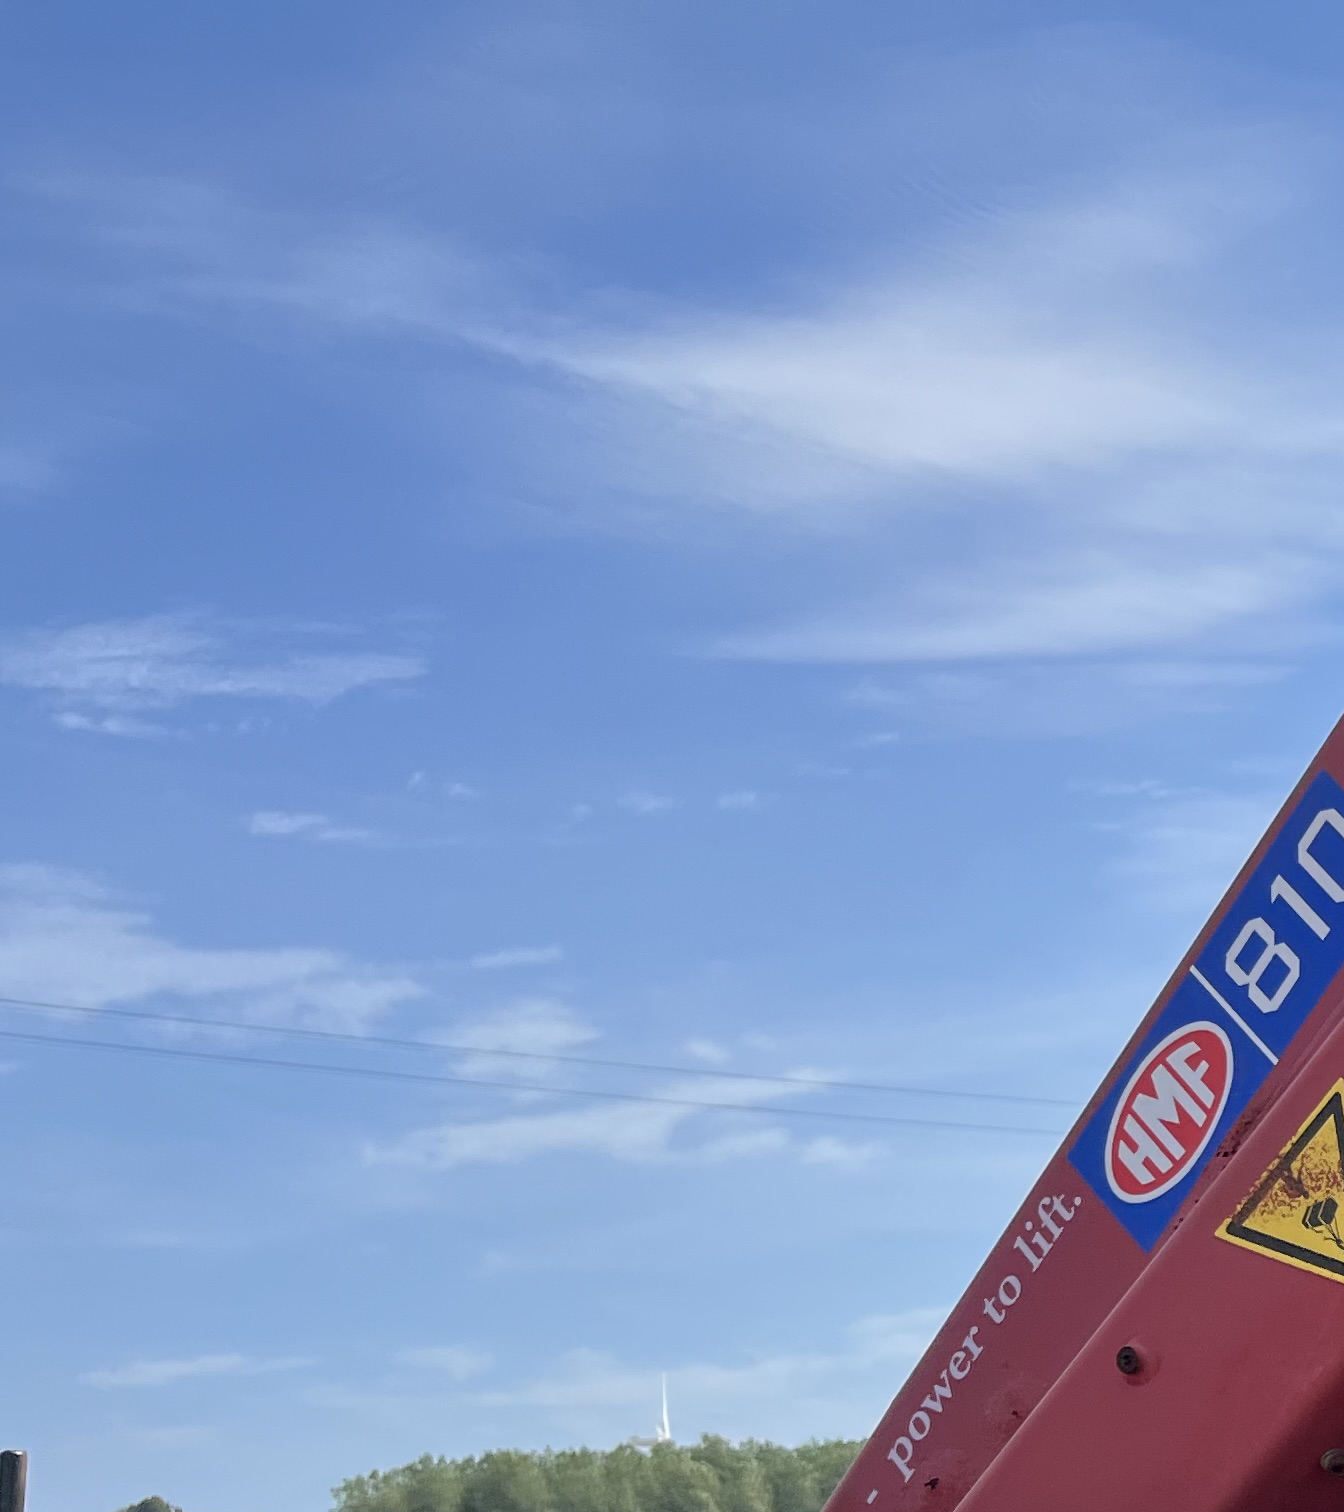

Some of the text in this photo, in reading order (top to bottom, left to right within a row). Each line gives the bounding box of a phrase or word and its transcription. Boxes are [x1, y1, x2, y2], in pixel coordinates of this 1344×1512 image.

[1117, 1040, 1216, 1186] HMF
[886, 1325, 984, 1483] power
[983, 1274, 1022, 1324] to
[1013, 1193, 1082, 1273] lift.
